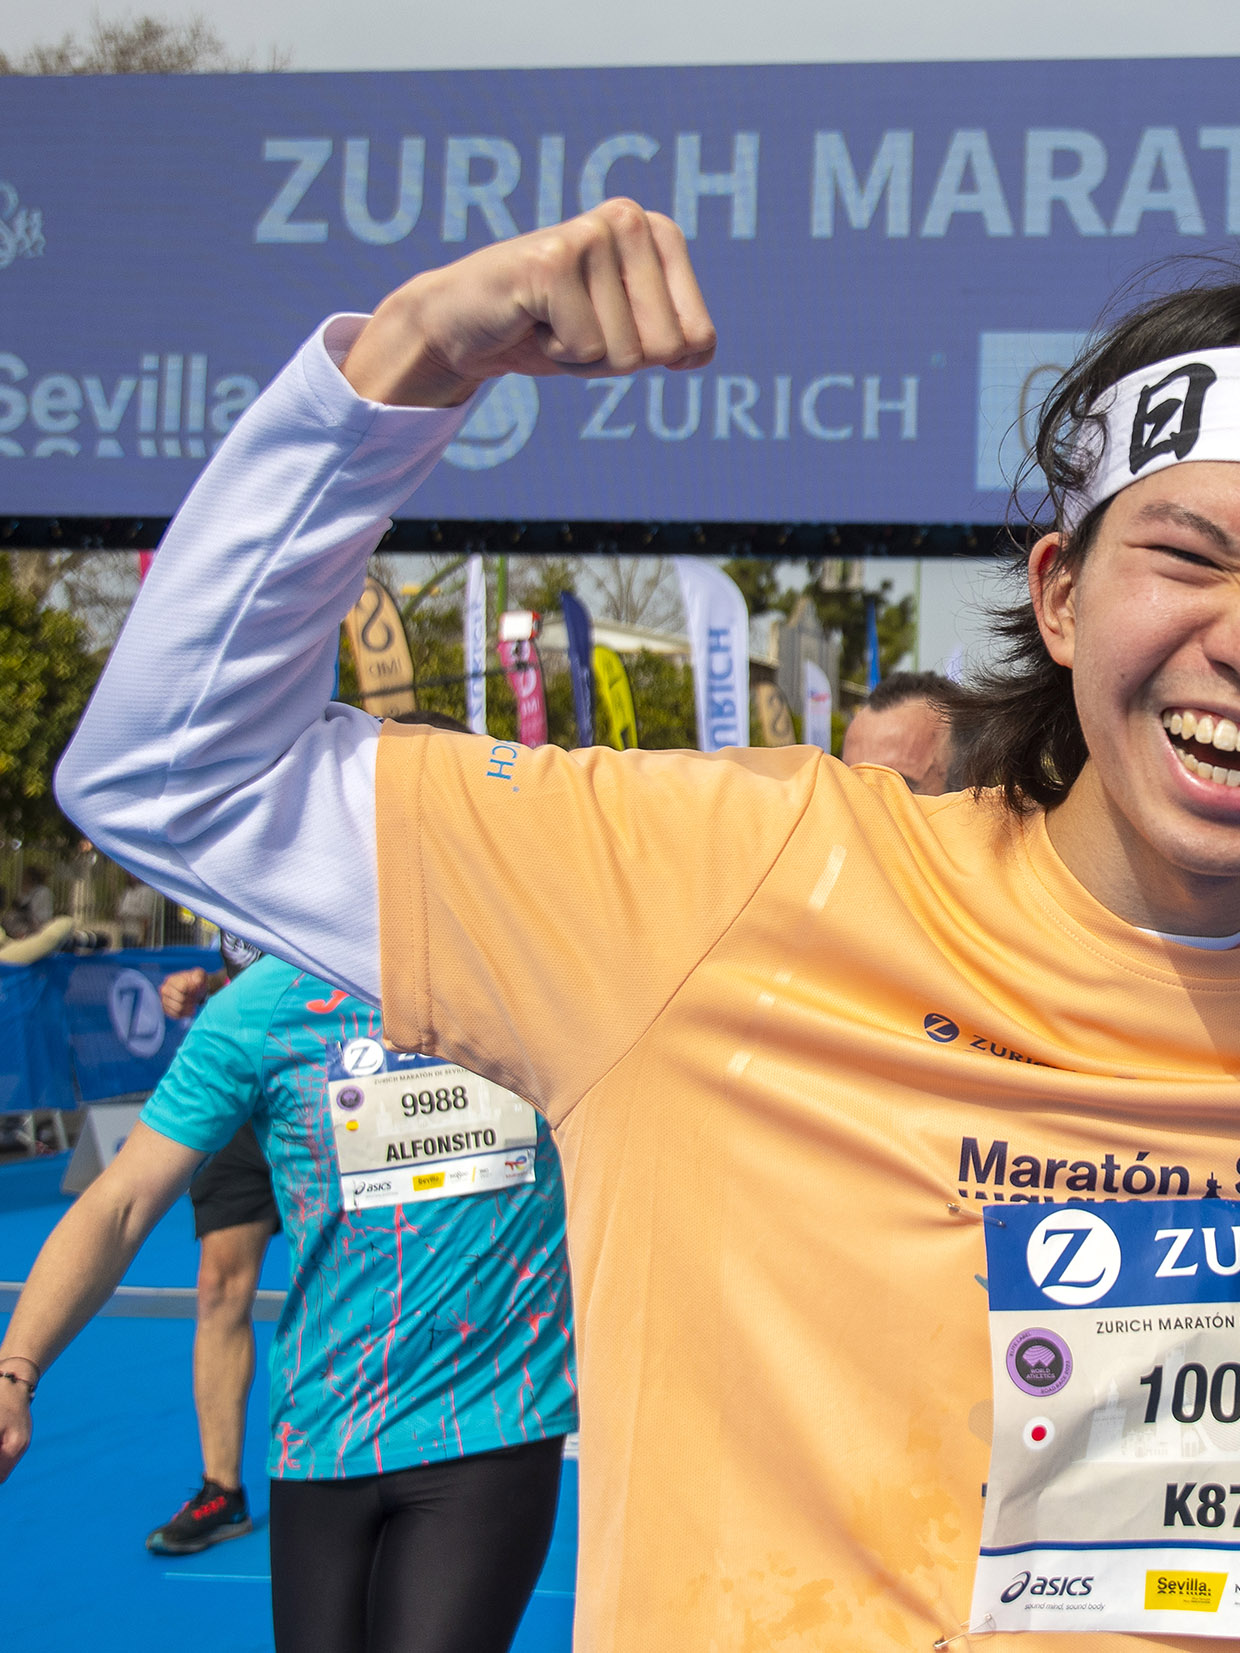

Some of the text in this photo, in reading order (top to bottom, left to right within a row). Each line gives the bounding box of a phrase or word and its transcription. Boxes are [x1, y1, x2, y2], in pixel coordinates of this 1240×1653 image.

[255, 132, 760, 246] ZURICH
[579, 373, 920, 441] ZURICH
[1129, 362, 1218, 475] 日
[487, 739, 521, 779] ICH
[969, 1034, 1060, 1070] ZURI
[401, 1086, 469, 1118] 9988
[386, 1128, 497, 1163] ALFONSITO
[957, 1136, 1190, 1197] Maratón
[1096, 1319, 1152, 1334] ZURICH
[1158, 1312, 1235, 1330] MARATÓN
[1030, 1575, 1095, 1596] asics
[1157, 1577, 1212, 1592] Sevilla.
[1066, 1602, 1087, 1610] sound
[1088, 1602, 1106, 1612] body
